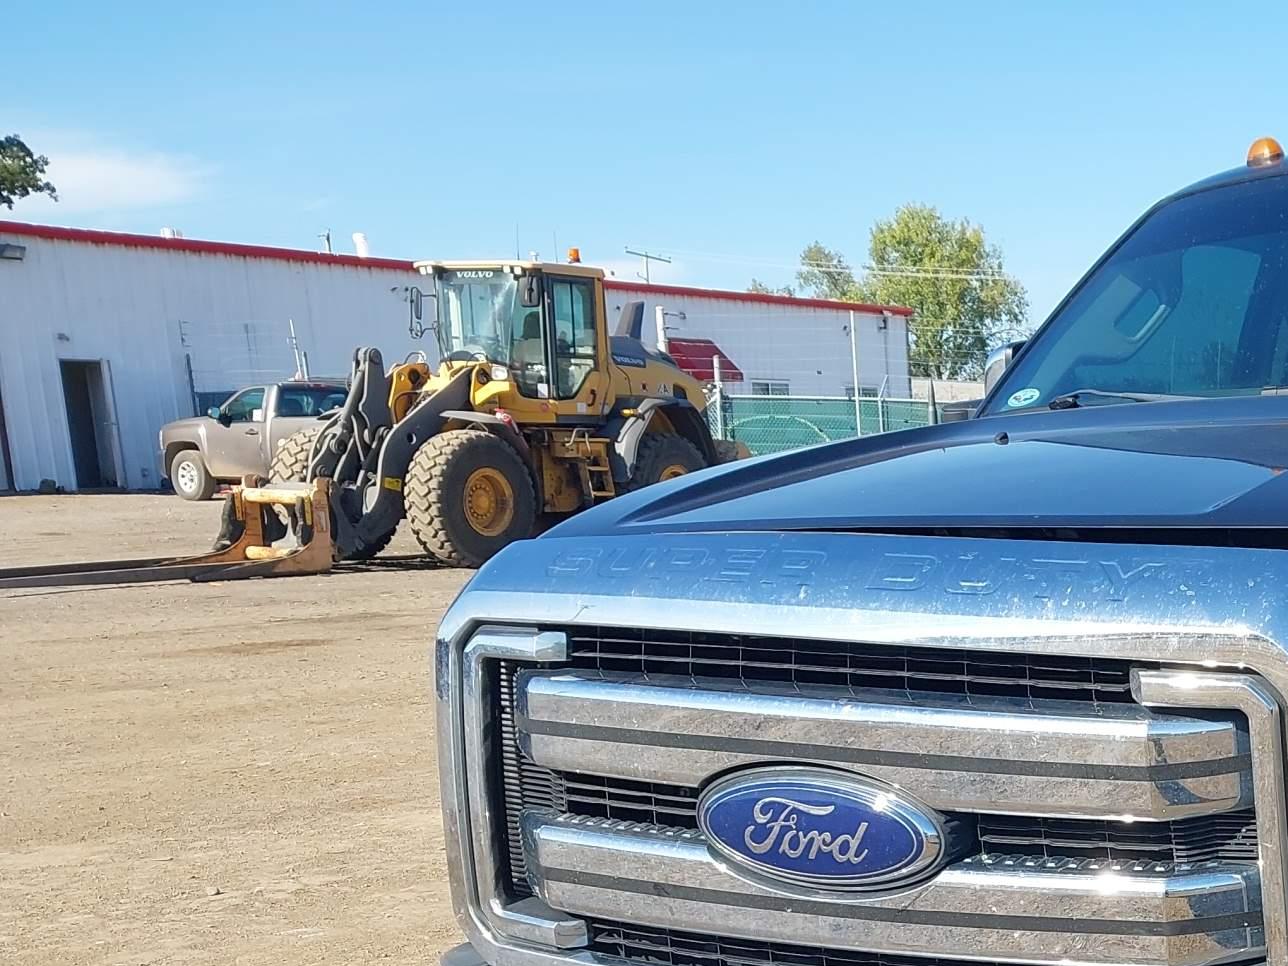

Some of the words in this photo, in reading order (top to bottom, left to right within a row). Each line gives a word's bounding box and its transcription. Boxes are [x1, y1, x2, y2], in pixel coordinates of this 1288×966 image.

[456, 270, 494, 279] VOLVO
[546, 546, 827, 587] SUPER
[864, 552, 1168, 602] DUTY
[744, 796, 868, 864] Ford
